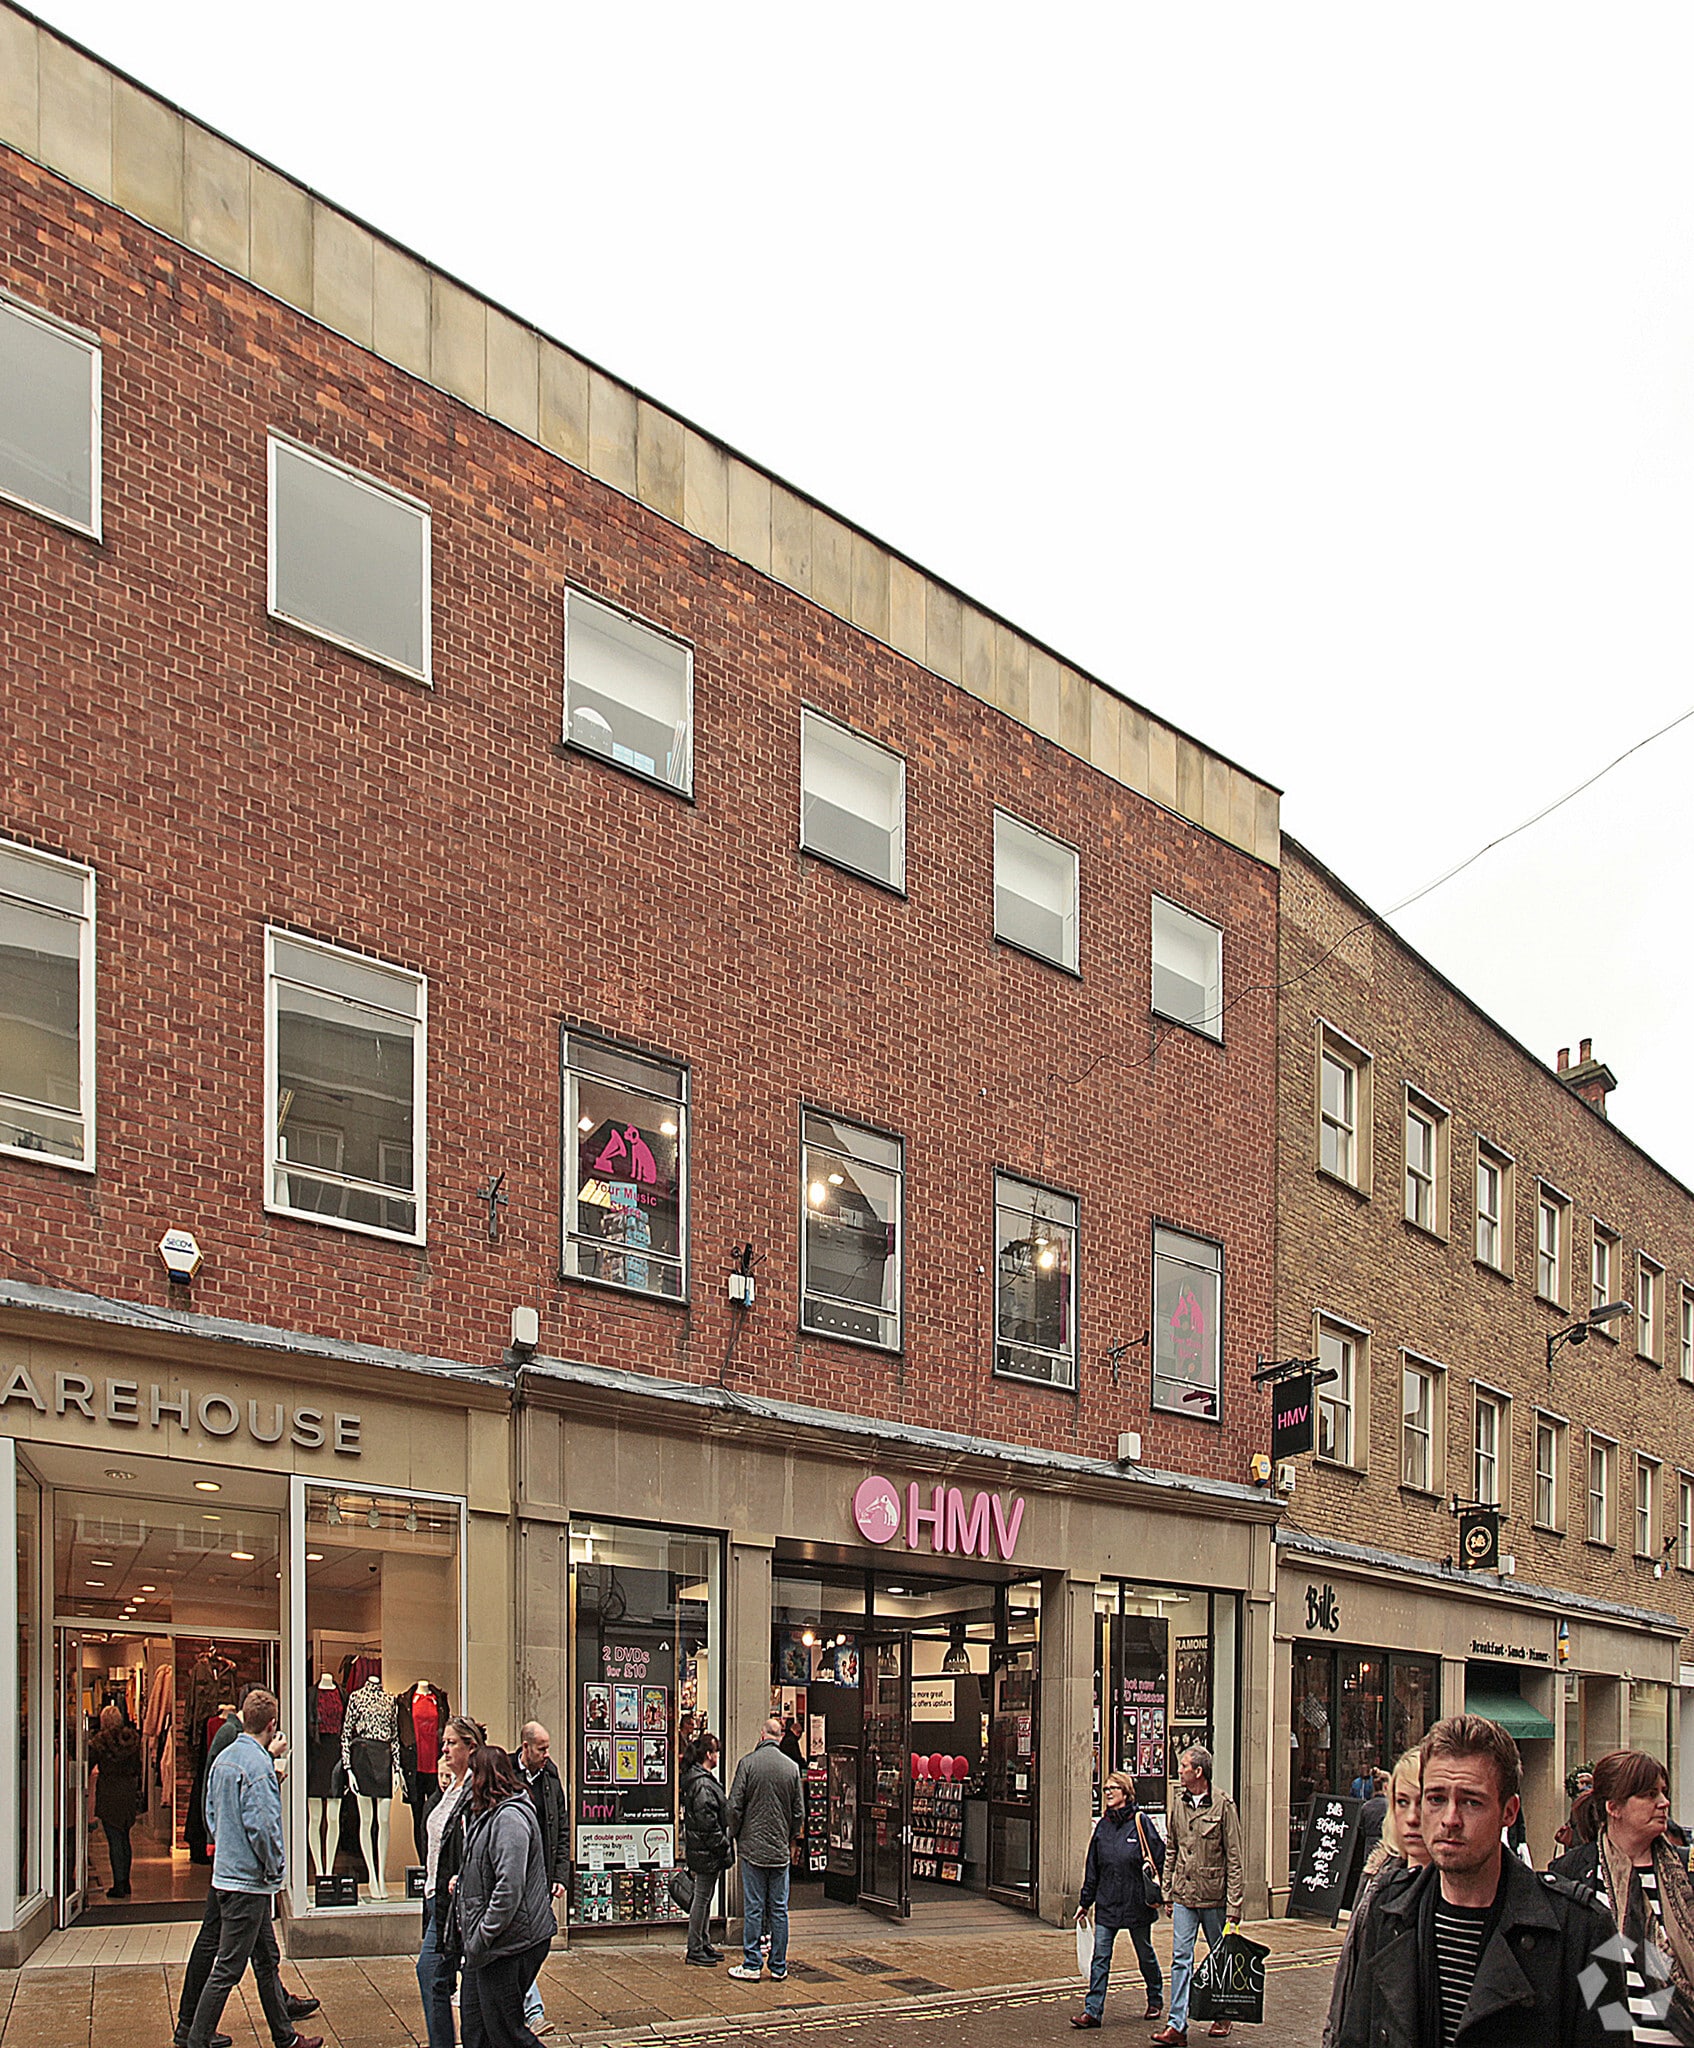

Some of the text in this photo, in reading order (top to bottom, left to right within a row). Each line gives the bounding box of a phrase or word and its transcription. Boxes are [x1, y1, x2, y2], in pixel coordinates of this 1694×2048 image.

[594, 1180, 657, 1206] Your Music
[610, 1201, 642, 1218] Store
[0, 1364, 362, 1455] AREHOUSE
[1278, 1404, 1308, 1430] HMV
[906, 1481, 1025, 1560] HMV
[1305, 1584, 1340, 1633] Bill's
[602, 1645, 650, 1664] 2 DVDs
[606, 1663, 647, 1679] for £10
[582, 1800, 615, 1818] hmv
[611, 1842, 622, 1850] buy
[615, 1834, 633, 1842] points
[1209, 1953, 1265, 1992] M&S
